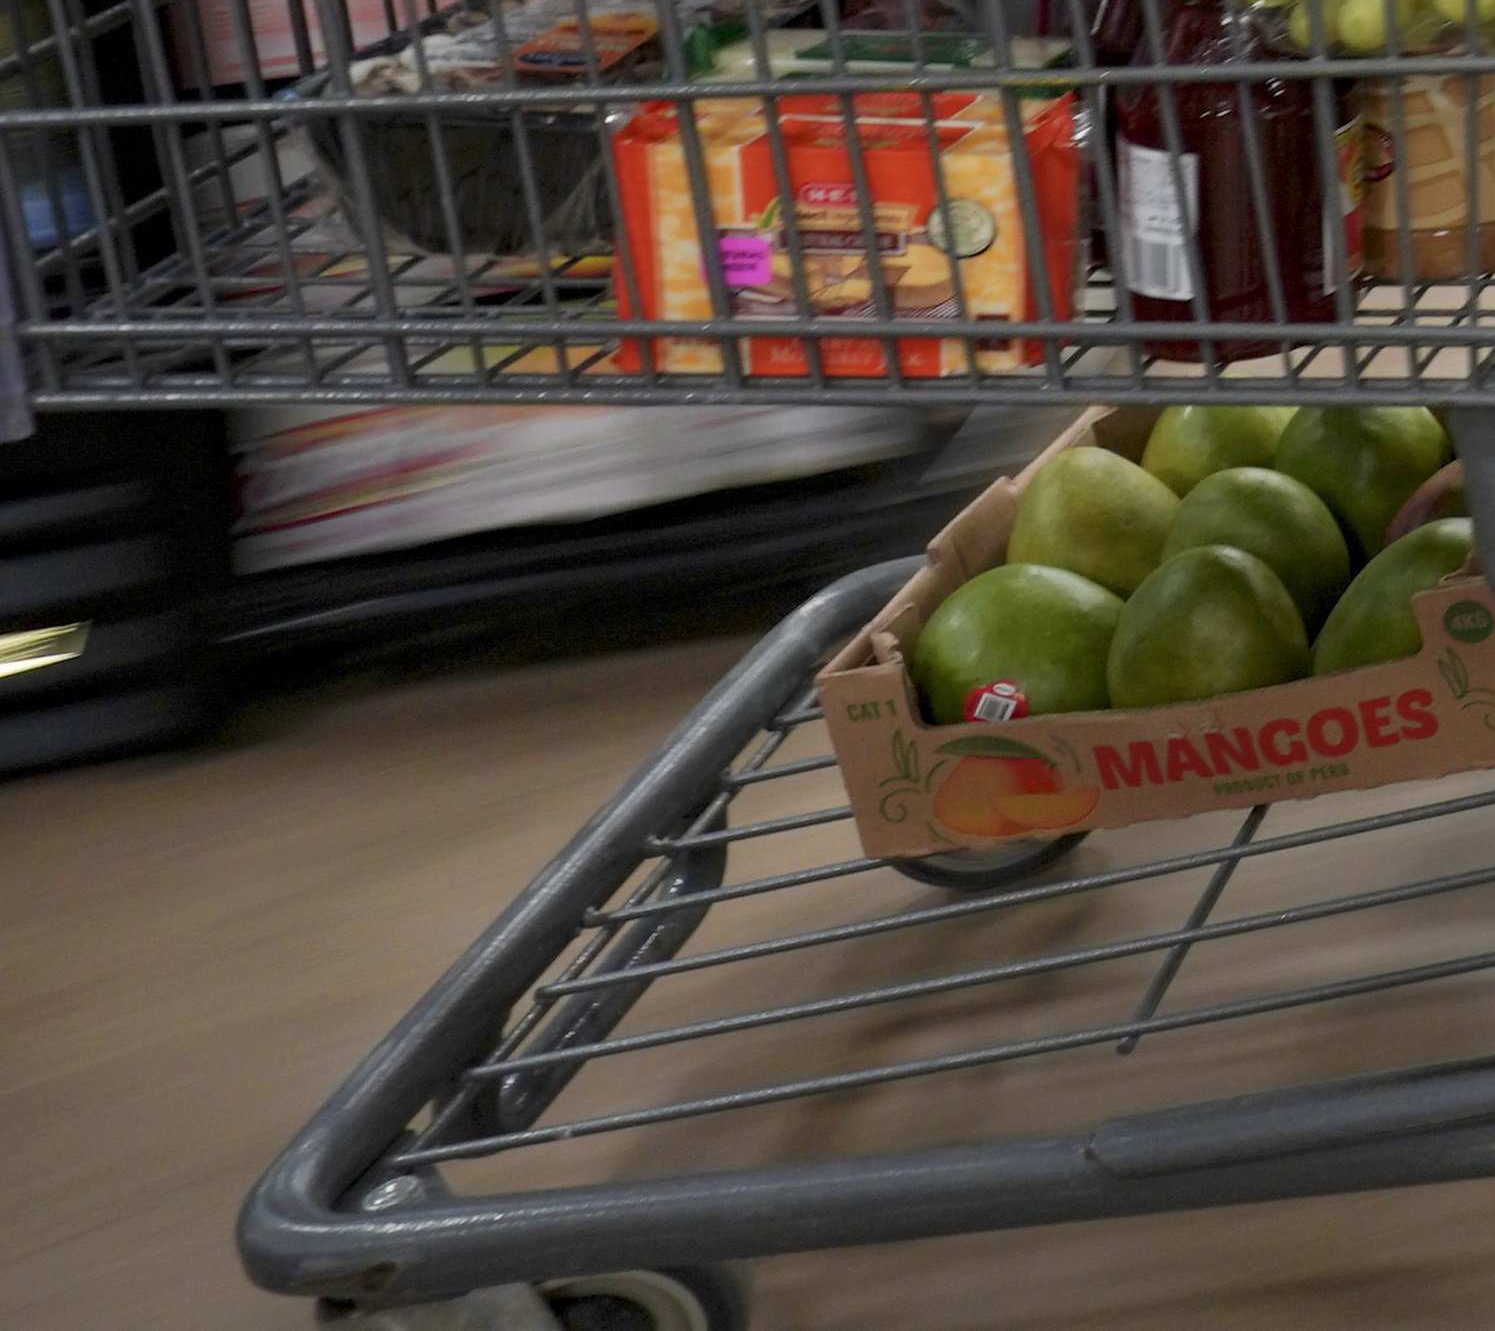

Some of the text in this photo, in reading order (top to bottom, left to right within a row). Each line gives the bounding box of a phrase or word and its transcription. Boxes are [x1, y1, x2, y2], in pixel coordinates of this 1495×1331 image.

[847, 699, 897, 722] CAT 1
[1093, 688, 1440, 791] MANGOES
[1214, 763, 1349, 795] PRODUCT OF PERU
